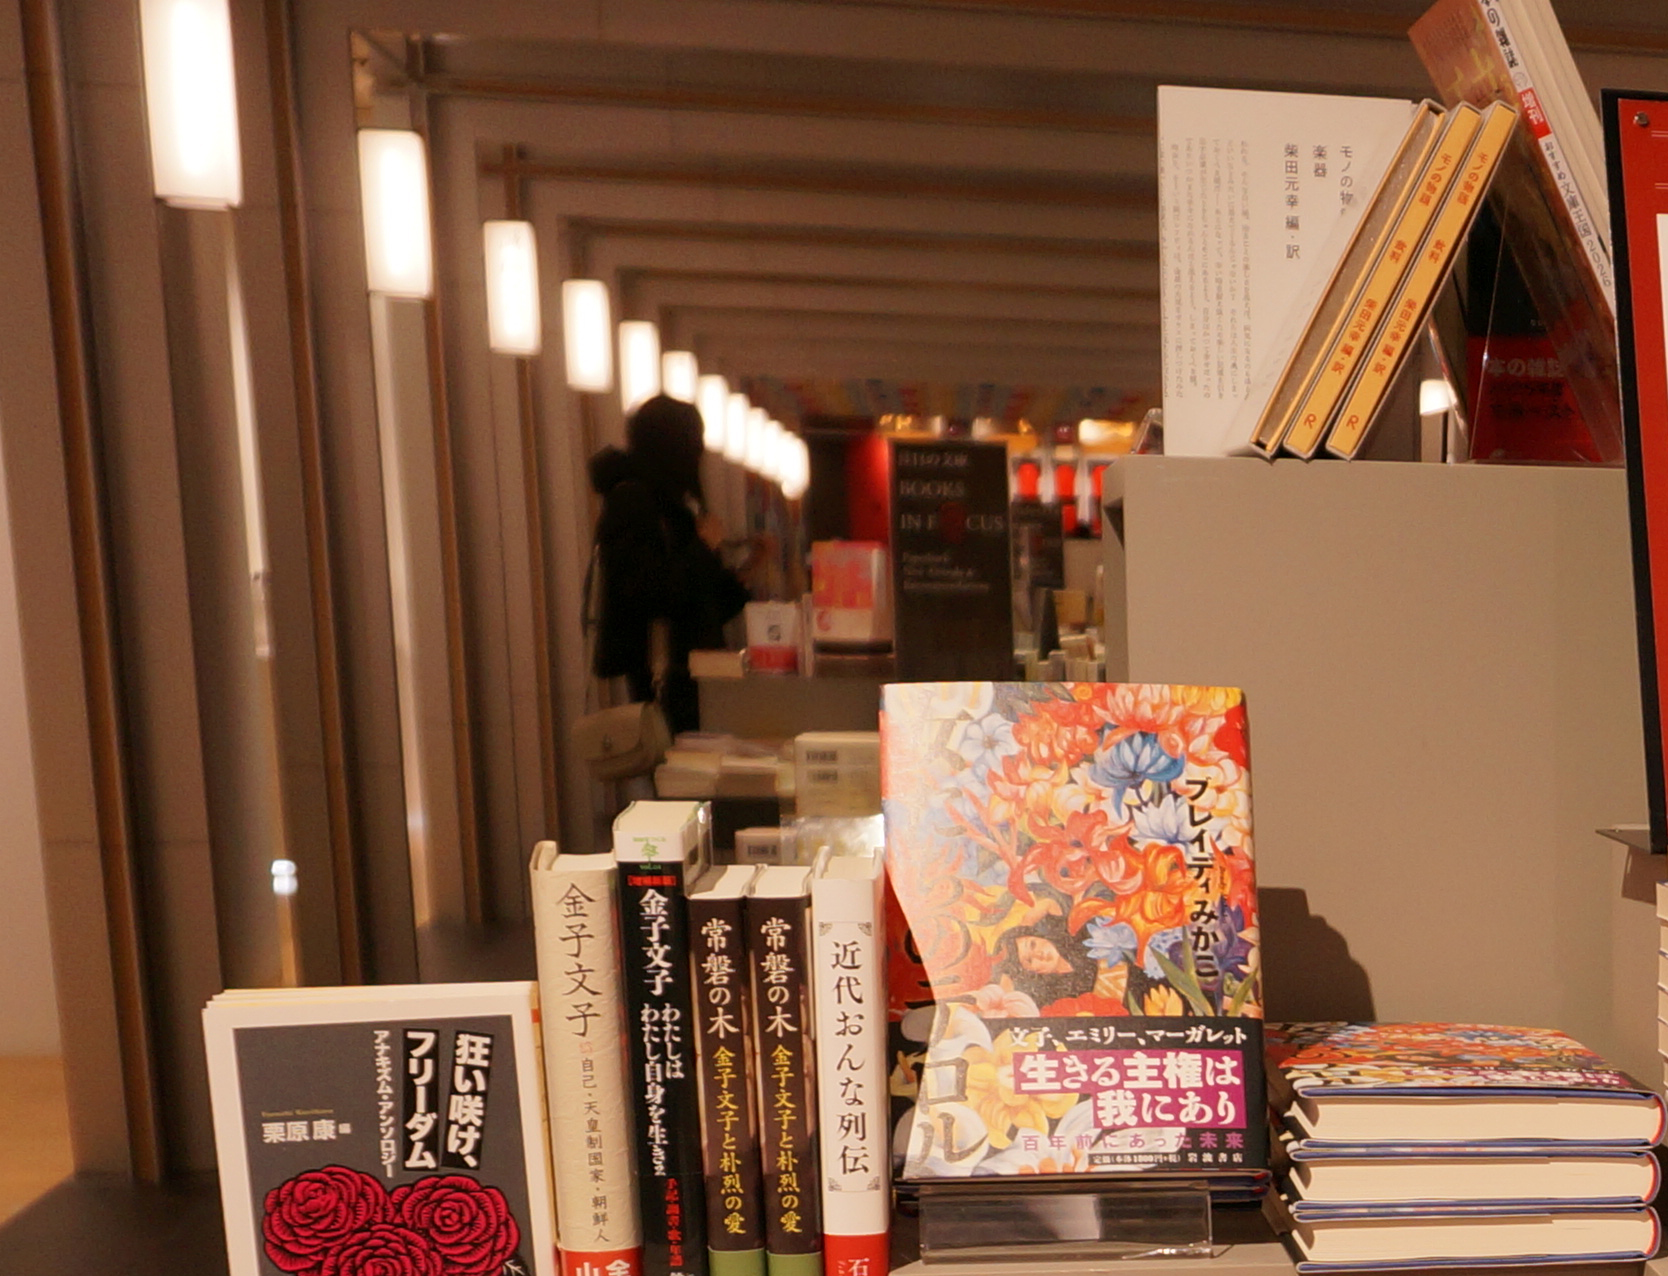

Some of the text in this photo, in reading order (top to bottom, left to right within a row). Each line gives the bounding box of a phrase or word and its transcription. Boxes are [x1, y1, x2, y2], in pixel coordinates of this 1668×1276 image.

[1481, 0, 1520, 69] の雑誌
[1283, 143, 1300, 260] 柴田元幸 編・訳
[1312, 144, 1328, 178] 楽器
[1339, 145, 1354, 206] モノの物
[1419, 152, 1453, 207] モノの物語
[1456, 152, 1489, 206] モノの物語
[1185, 776, 1220, 978] ブレイディみかこ
[561, 882, 603, 1038] 金子文子
[638, 888, 674, 997] 金子文子
[660, 1002, 685, 1080] わたしは
[831, 940, 870, 1176] 近代おんな列伝
[1009, 1025, 1248, 1048] 文子、エミリー、マーガレット
[1019, 1050, 1242, 1091] 生きる主権は
[373, 1030, 397, 1178] アナキズム・アンソロジー
[405, 1031, 438, 1169] フリーダム
[446, 1034, 491, 1168] 狂い咲け、
[712, 1045, 747, 1235] 金子文子と朴烈の愛
[770, 1044, 803, 1234] 金子文子と朴烈の愛
[1021, 1131, 1245, 1152] 百年前にあった未来
[1096, 1089, 1237, 1127] 我にあり
[581, 1058, 610, 1244] 自己・天皇制国家・朝鮮人
[1187, 1152, 1244, 1164] 岩波書店
